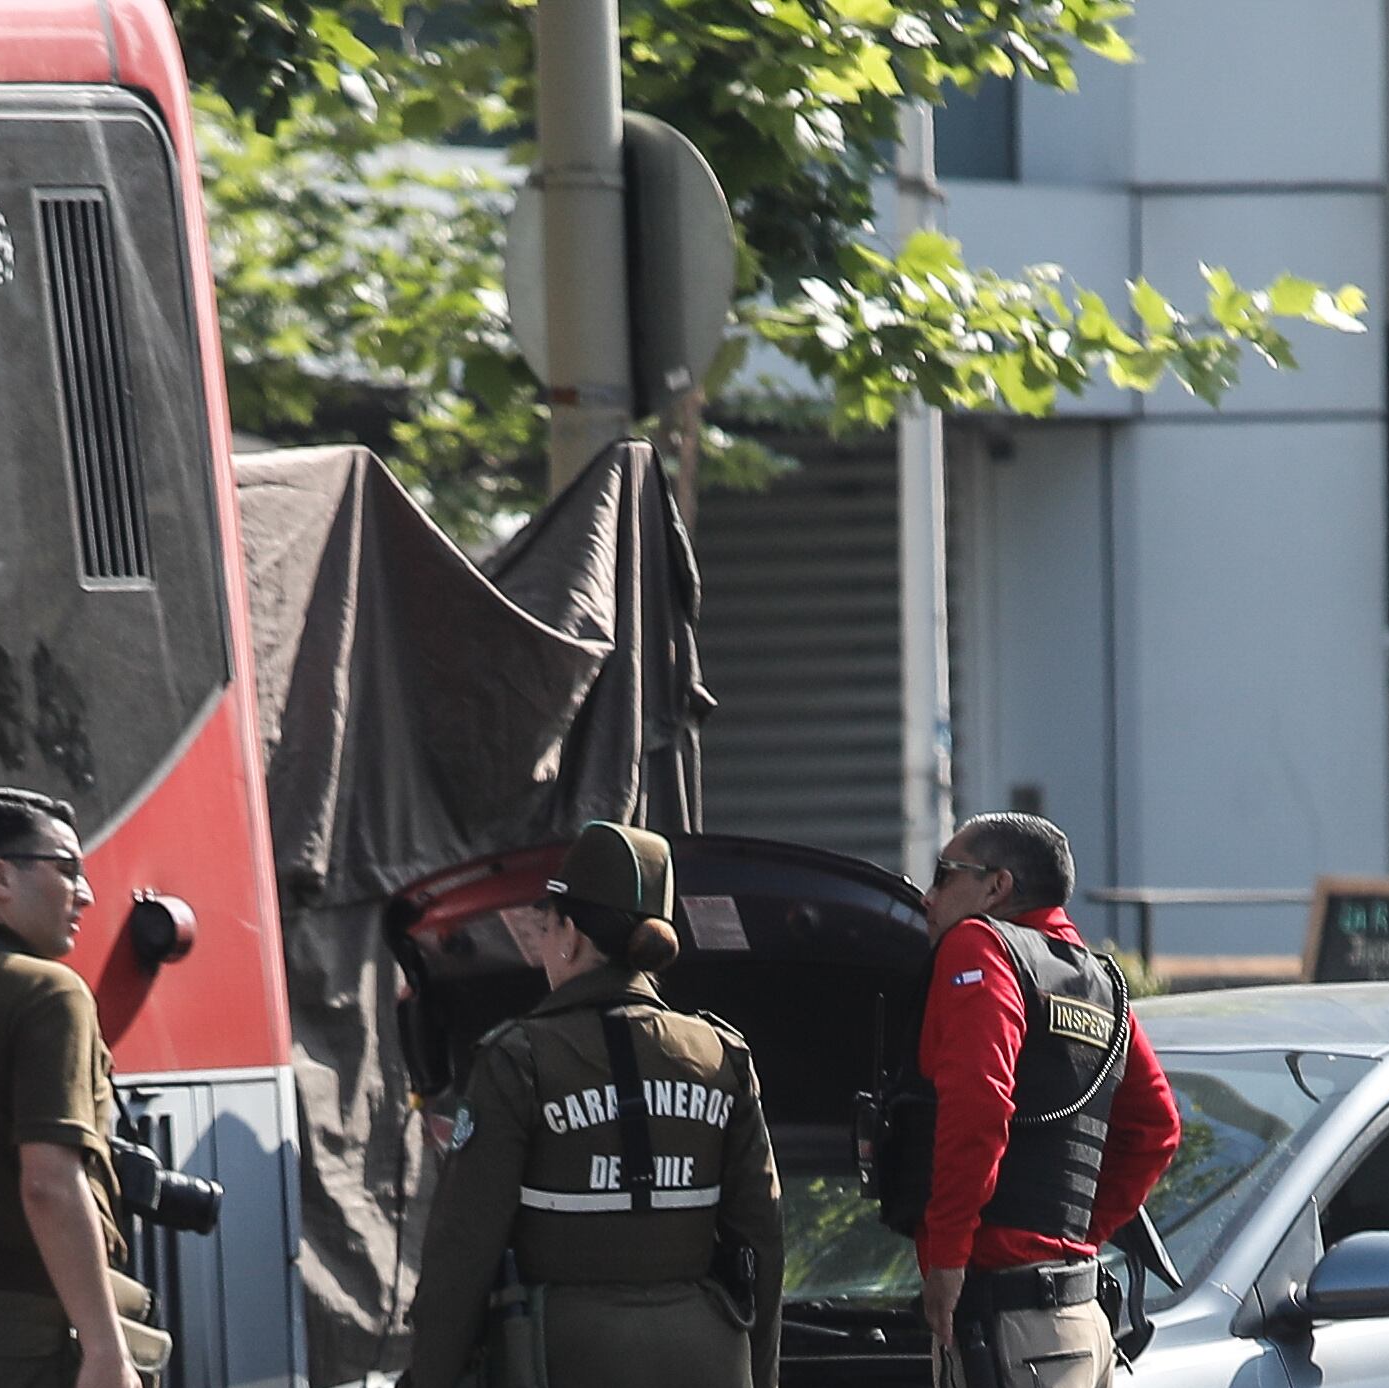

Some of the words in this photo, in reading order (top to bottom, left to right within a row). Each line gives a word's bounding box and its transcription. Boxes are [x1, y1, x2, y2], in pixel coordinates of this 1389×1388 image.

[1056, 1004, 1114, 1042] INSPECT
[542, 1078, 735, 1135] CARAINEROS
[589, 1154, 622, 1190] DE
